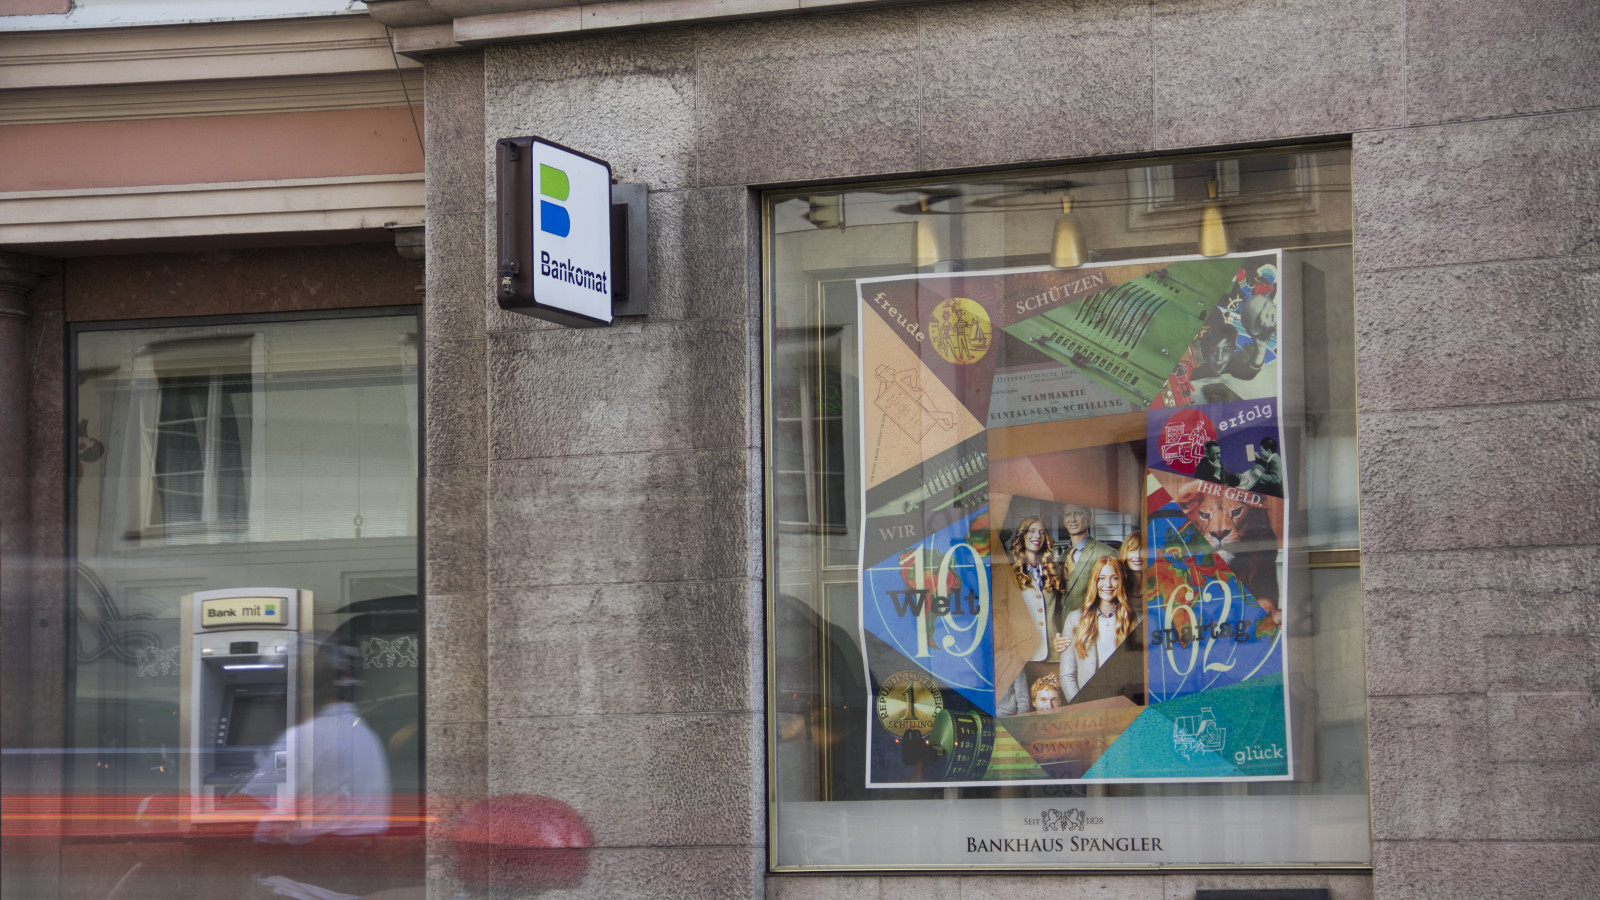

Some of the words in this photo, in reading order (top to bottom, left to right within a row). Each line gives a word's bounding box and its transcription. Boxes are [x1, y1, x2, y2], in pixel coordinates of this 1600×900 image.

[541, 250, 607, 294] Bankomat
[1016, 272, 1105, 314] SCHÜTZEN
[873, 292, 925, 342] freude
[1021, 388, 1087, 402] STAMMAKTIE
[990, 405, 1058, 420] EINTAUSEND
[1063, 399, 1123, 412] SCHILLING
[1218, 403, 1273, 431] erfolg
[1197, 480, 1222, 497] IHR
[1224, 486, 1263, 506] GELD.
[879, 524, 917, 542] WIR
[207, 608, 237, 618] Bank
[241, 605, 261, 617] mit
[886, 588, 981, 618] Welt
[899, 542, 990, 658] 19
[1151, 617, 1251, 651] spartag
[1164, 579, 1237, 676] 62
[901, 681, 919, 720] 1
[1028, 718, 1117, 735] BANKHAUS
[1234, 743, 1284, 765] glück
[1024, 817, 1040, 826] SEIT
[1086, 816, 1104, 825] 1828
[966, 837, 1064, 853] BANKHAUS
[1070, 835, 1164, 852] SPÄNGLER
